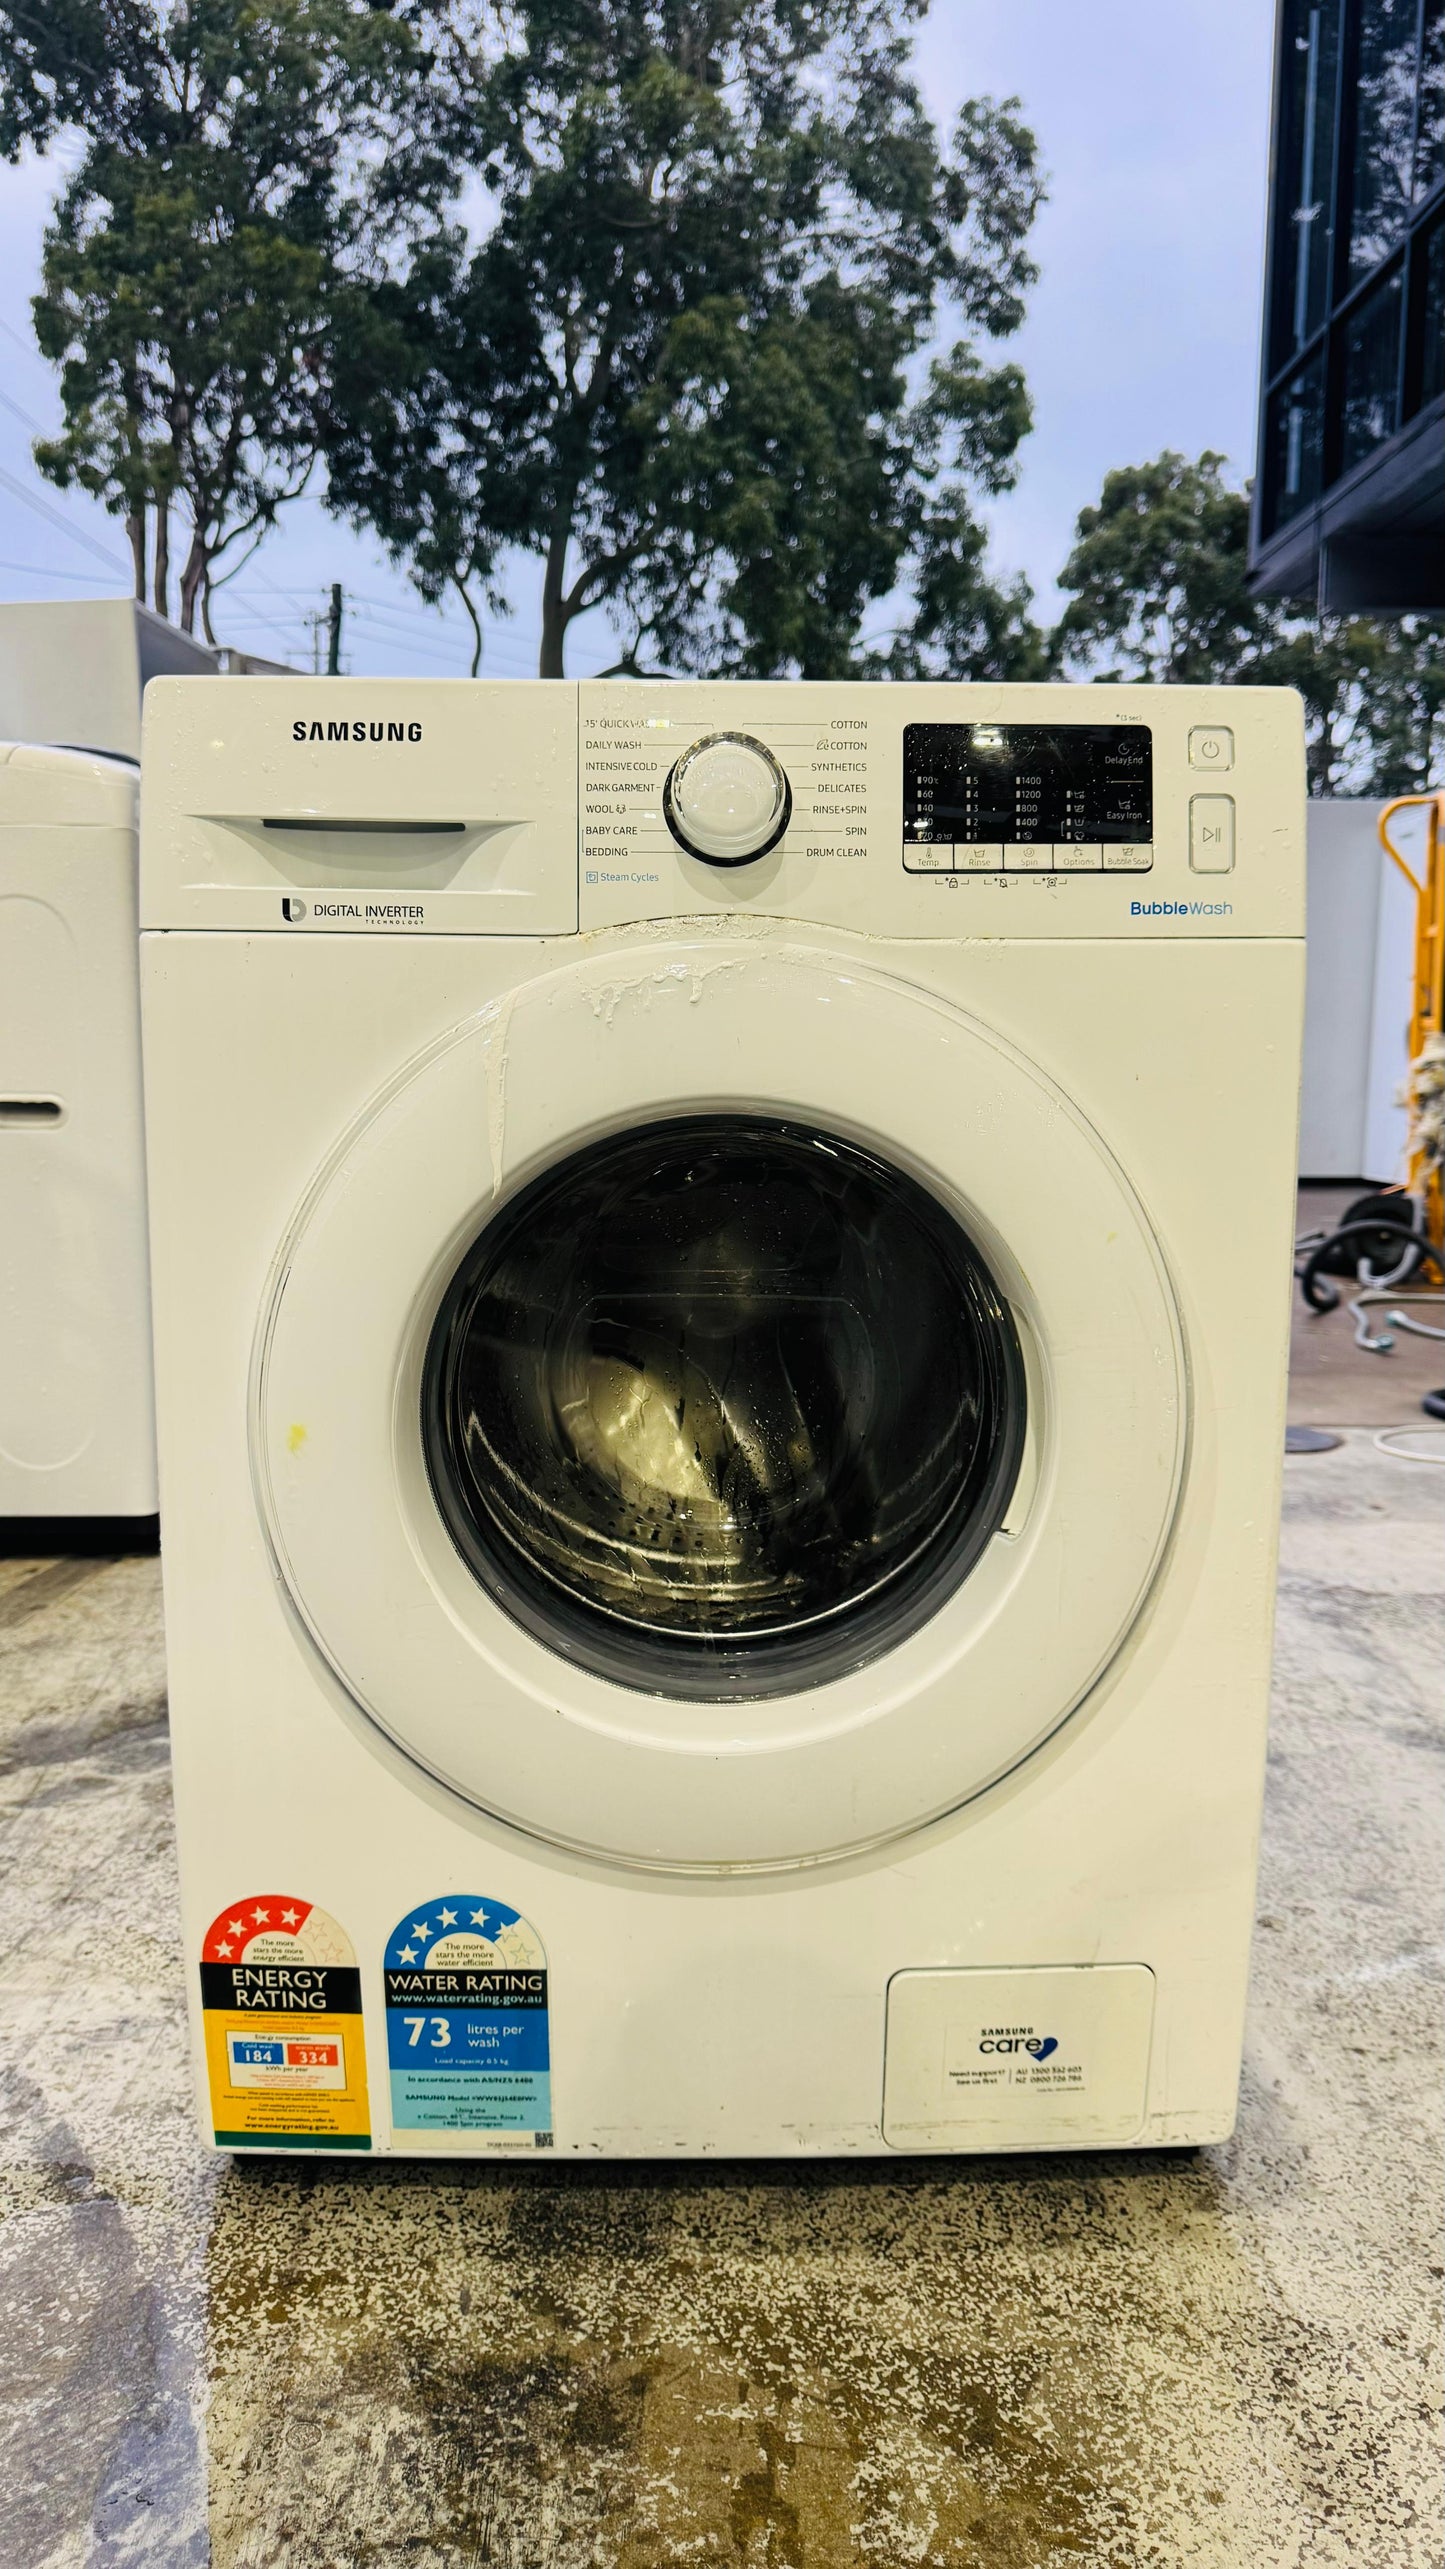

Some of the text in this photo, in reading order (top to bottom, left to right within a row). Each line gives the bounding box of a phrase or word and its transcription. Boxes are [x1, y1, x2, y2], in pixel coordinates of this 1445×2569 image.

[600, 719, 629, 729] QUICK
[831, 721, 867, 729] COTTON
[293, 721, 422, 742] SAMSUNG
[586, 741, 641, 749] DAILY WASH
[830, 742, 867, 750] COTTON
[586, 762, 657, 771] INTENSIVE COLD
[811, 763, 867, 771] SYNTHETICS
[974, 776, 979, 784] 5
[1021, 776, 1041, 785] 1400
[586, 784, 655, 792] DARK GARMENT
[818, 784, 867, 793] DELICATES
[973, 790, 979, 798] 4
[1021, 790, 1041, 799] 1200
[586, 805, 613, 813] WOOL
[813, 805, 867, 814] RINSE+SPIN
[923, 804, 933, 812] 40
[973, 804, 979, 812] 3
[1021, 804, 1038, 813] 800
[1106, 811, 1142, 821] Easy Iron
[973, 818, 979, 826] 2
[1021, 818, 1038, 826] 400
[585, 826, 638, 835] BABY CARE
[845, 827, 867, 835] SPIN
[585, 848, 628, 856] BEDDING
[806, 848, 867, 857] DRUM CLEAN
[918, 858, 939, 868] Temp
[969, 858, 991, 866] Rinse
[1021, 858, 1038, 868] Spin
[1063, 857, 1095, 867] Options
[1107, 857, 1149, 866] Bubble Soak
[600, 872, 659, 883] Steam Cycles
[314, 904, 424, 918] DIGITAL INVERTER
[1131, 901, 1233, 916] BubbleWash
[445, 1942, 460, 1950] The
[252, 1955, 276, 1963] energy
[462, 1959, 493, 1967] efficient
[232, 1968, 328, 1989] ENERGY
[388, 1975, 543, 1991] WATER RATING
[236, 1989, 327, 2010] RATING
[392, 1993, 542, 2006] www.waterrating.gov.au
[403, 2016, 451, 2048] 73
[467, 2023, 524, 2037] litres per
[981, 2027, 1034, 2036] SAMSUNG
[468, 2037, 500, 2048] wash
[979, 2038, 1042, 2054] care
[245, 2049, 272, 2063] 184
[299, 2051, 328, 2064] 334
[455, 2058, 484, 2066] capacity
